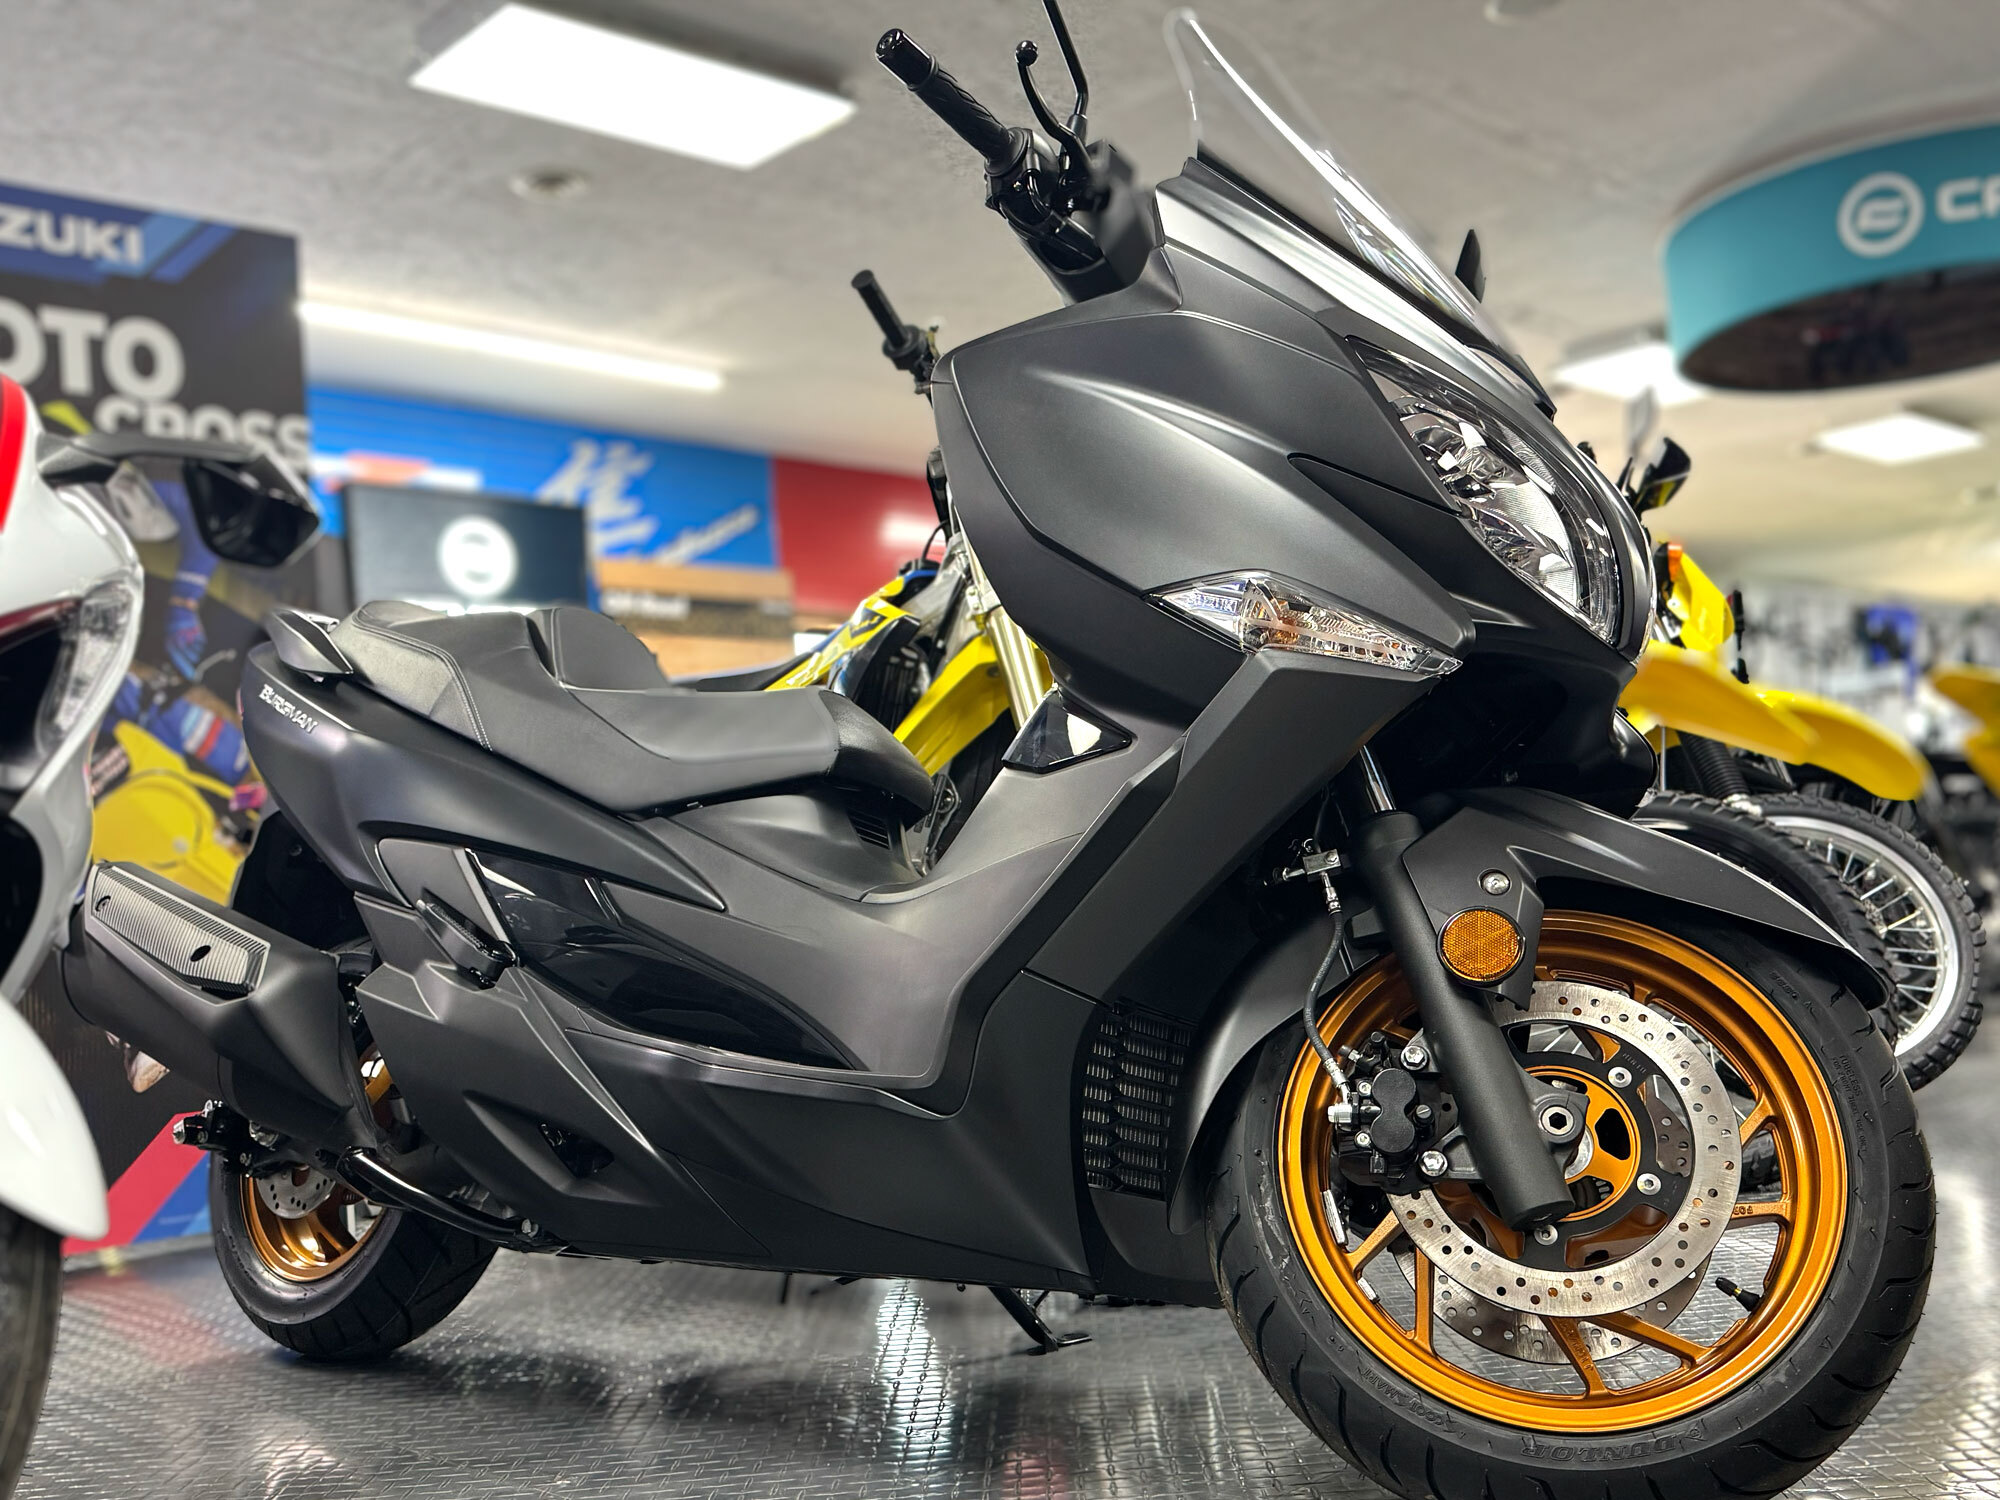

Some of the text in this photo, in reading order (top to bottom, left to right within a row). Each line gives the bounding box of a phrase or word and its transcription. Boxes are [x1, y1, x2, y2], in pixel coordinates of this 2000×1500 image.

[259, 684, 318, 733] BURGMAN
[1839, 1055, 1863, 1097] TUBELESS
[1521, 1434, 1679, 1463] DUNLOP
